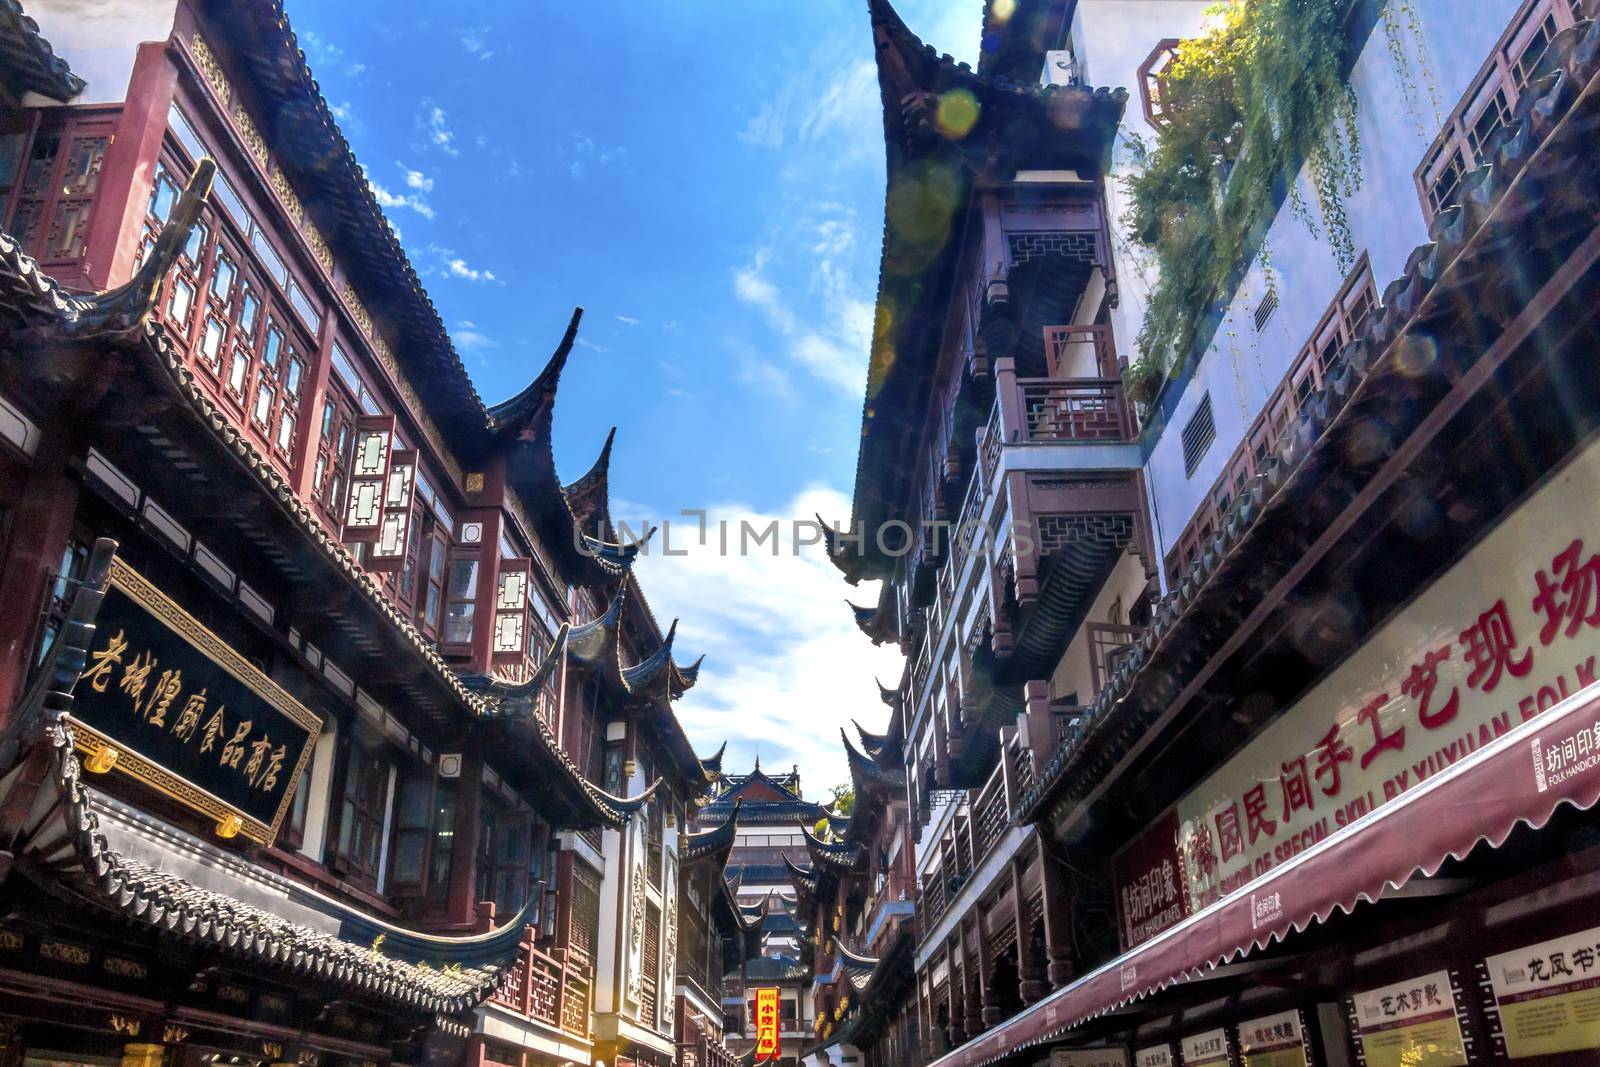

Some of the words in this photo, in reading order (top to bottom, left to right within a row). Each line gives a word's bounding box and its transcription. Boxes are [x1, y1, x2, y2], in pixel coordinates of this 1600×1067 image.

[1548, 772, 1567, 787] FOLK
[1129, 858, 1177, 921] 坊间印象
